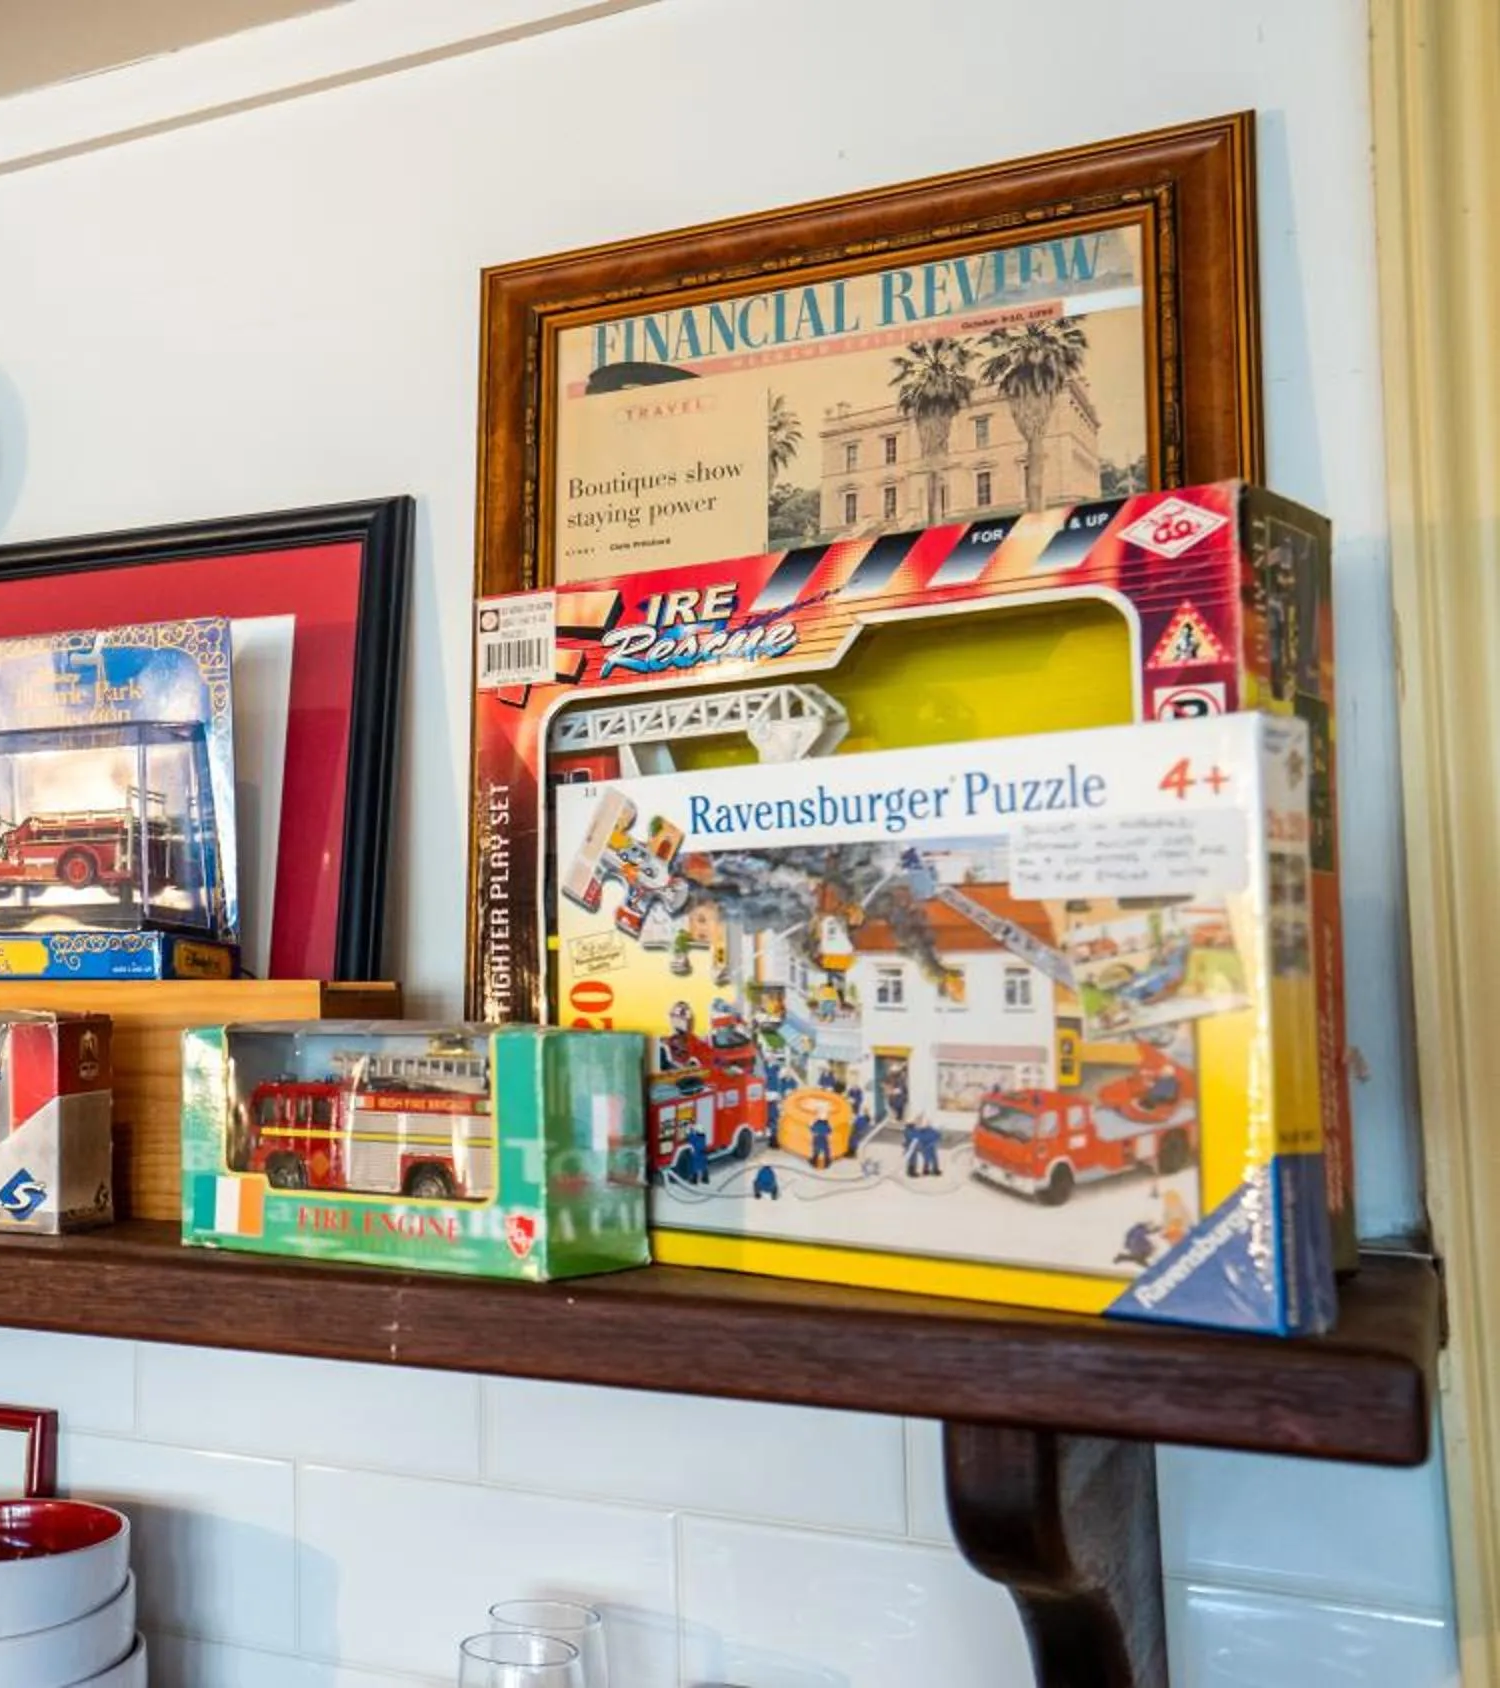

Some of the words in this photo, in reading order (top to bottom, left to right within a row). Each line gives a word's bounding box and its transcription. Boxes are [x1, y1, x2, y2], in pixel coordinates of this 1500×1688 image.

[591, 279, 861, 367] FINANCIAL
[881, 235, 1100, 325] REVIEW
[626, 400, 701, 421] TRAVEL
[569, 471, 677, 499] Boutiques
[686, 461, 744, 483] show
[567, 503, 642, 532] staying
[649, 496, 717, 526] power
[971, 528, 1003, 544] FOR
[1085, 512, 1109, 527] UP
[601, 622, 798, 678] Rescue
[1159, 757, 1231, 799] 4+
[489, 784, 510, 827] SET
[689, 784, 950, 835] Ravensburger
[964, 764, 1106, 815] Puzzle
[490, 836, 510, 900] PLAY
[297, 1206, 356, 1234] FIRE
[363, 1210, 458, 1240] ENGINE
